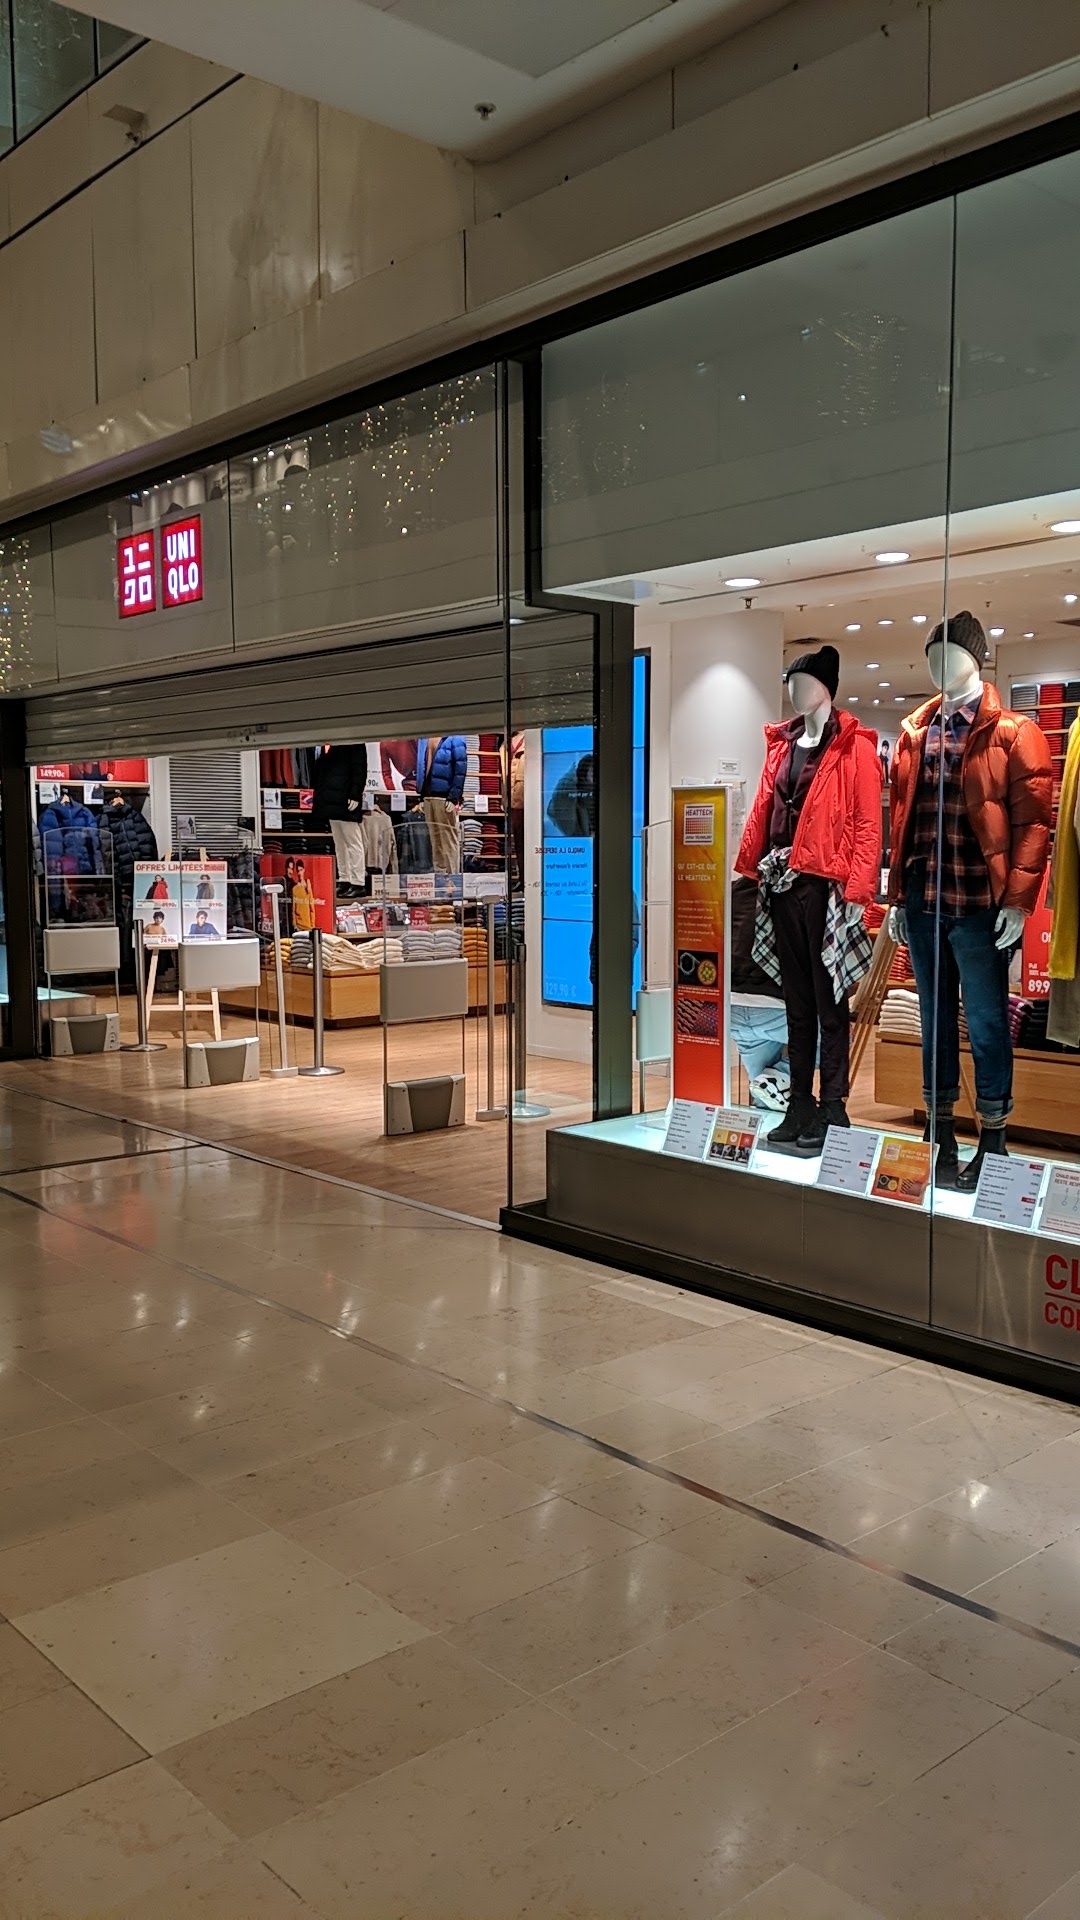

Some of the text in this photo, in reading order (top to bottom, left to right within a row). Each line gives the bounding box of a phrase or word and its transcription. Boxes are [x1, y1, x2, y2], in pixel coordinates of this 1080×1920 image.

[166, 528, 196, 563] UNI
[167, 561, 199, 600] QLO
[685, 808, 713, 816] HEATTECH
[135, 863, 166, 872] OFFRES
